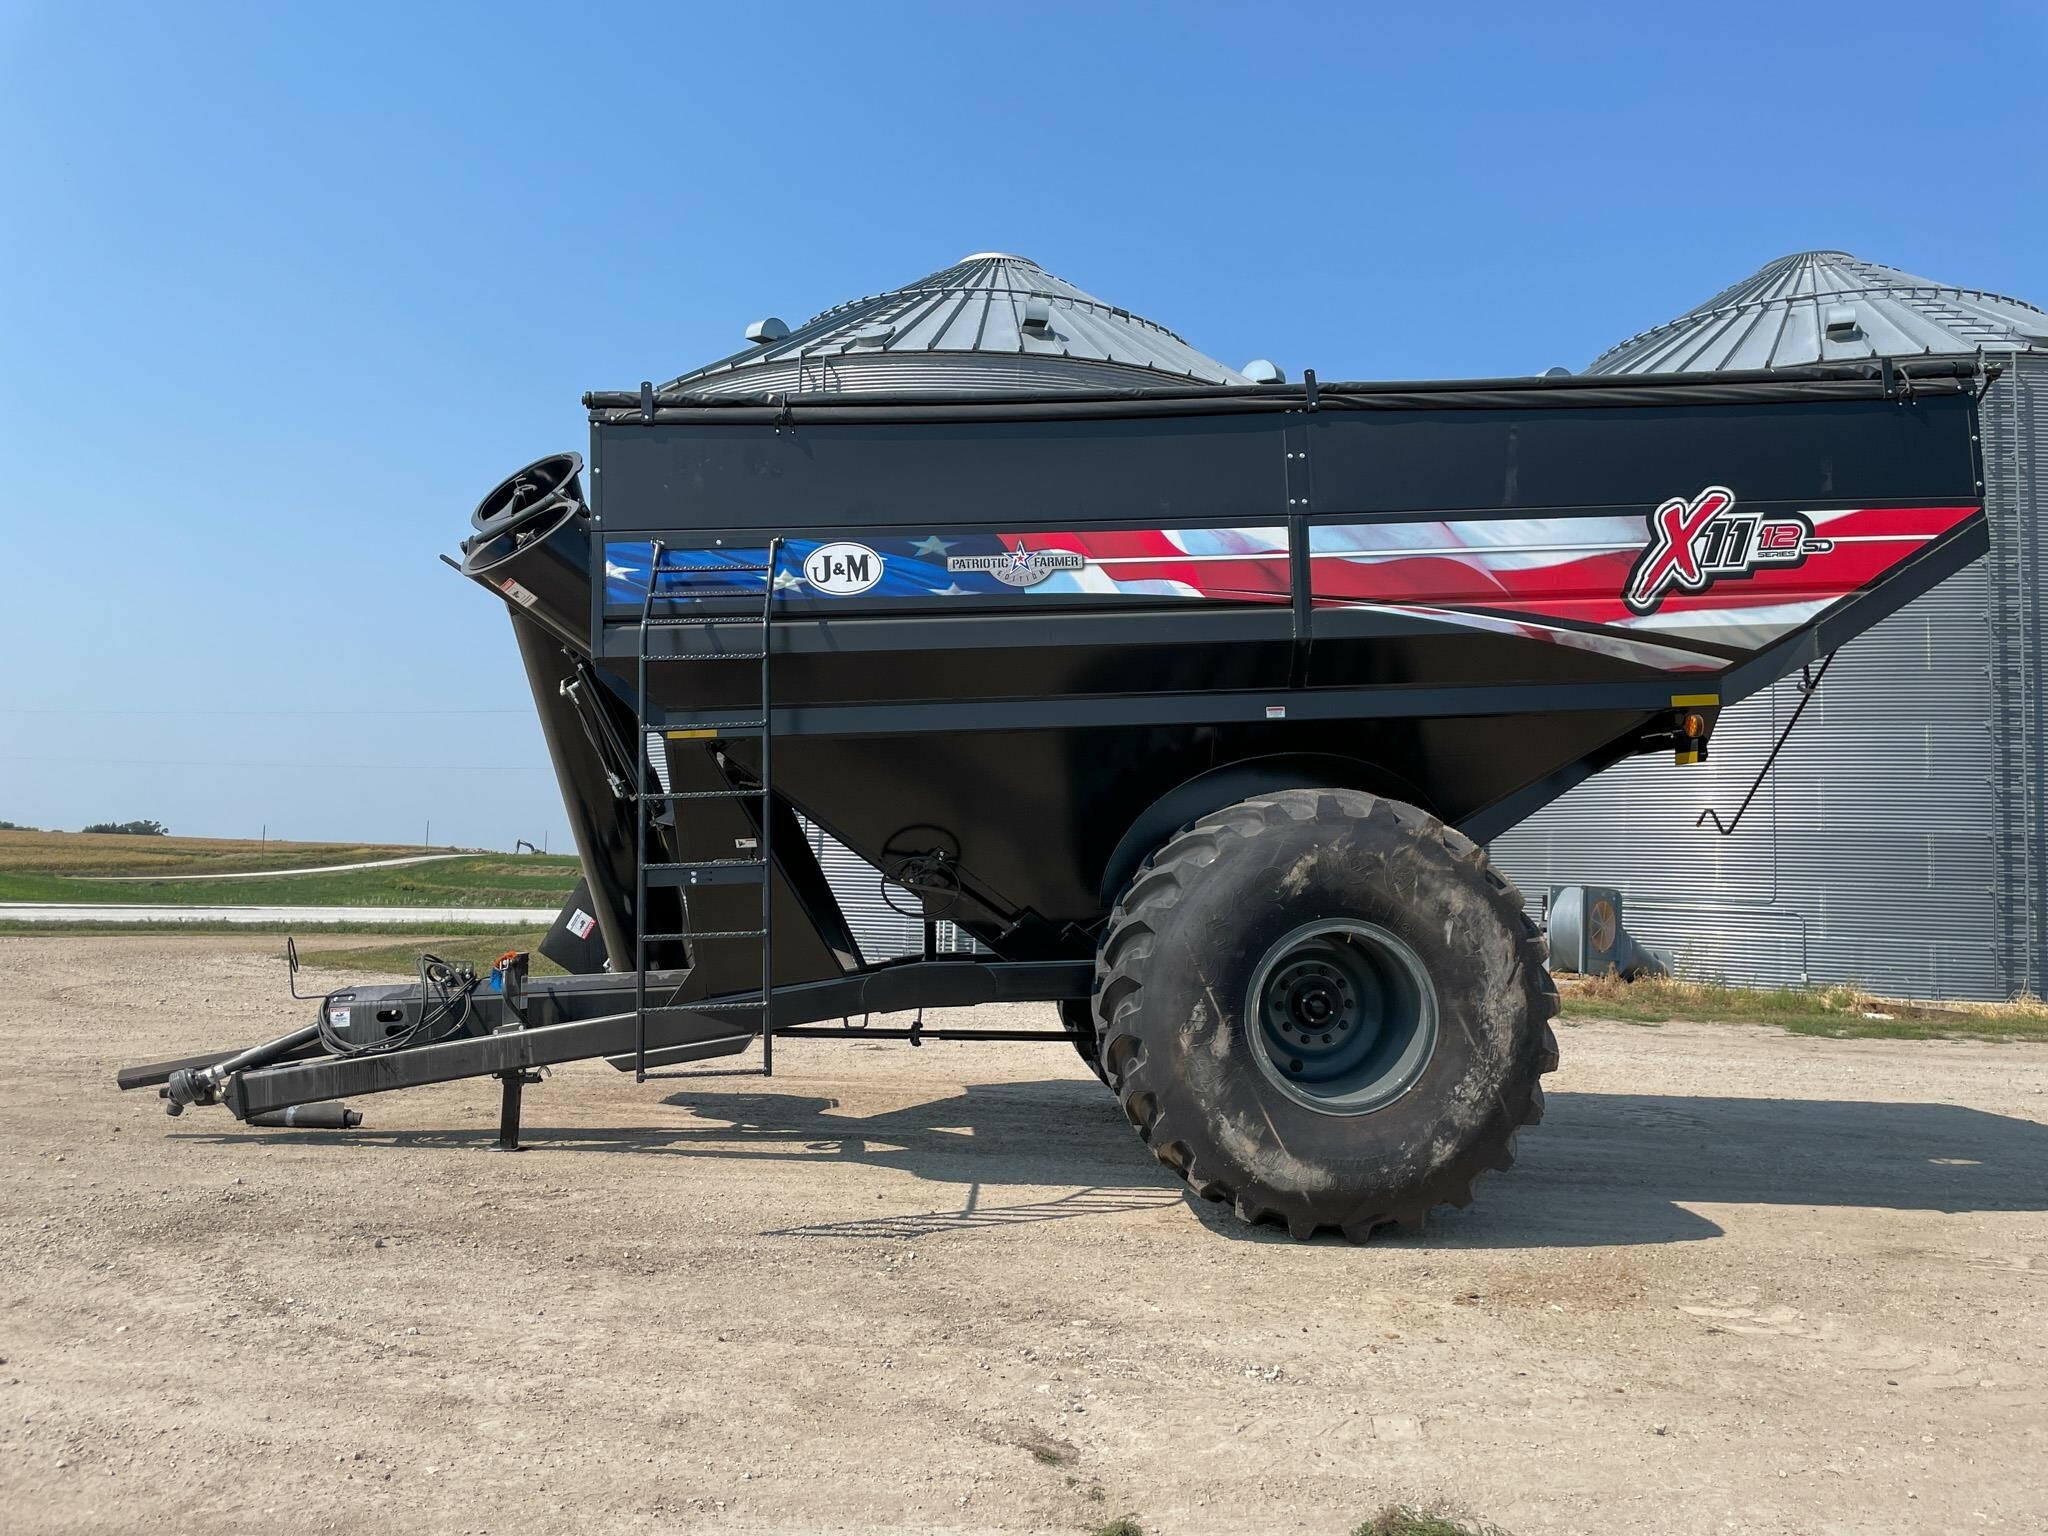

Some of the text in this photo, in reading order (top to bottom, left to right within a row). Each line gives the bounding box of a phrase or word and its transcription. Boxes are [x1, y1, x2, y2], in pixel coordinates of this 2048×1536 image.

[1757, 550, 1796, 559] SERIES
[811, 554, 871, 584] J&M
[952, 555, 1079, 570] PATRIOTIC FARMER
[996, 568, 1046, 584] EDITION
